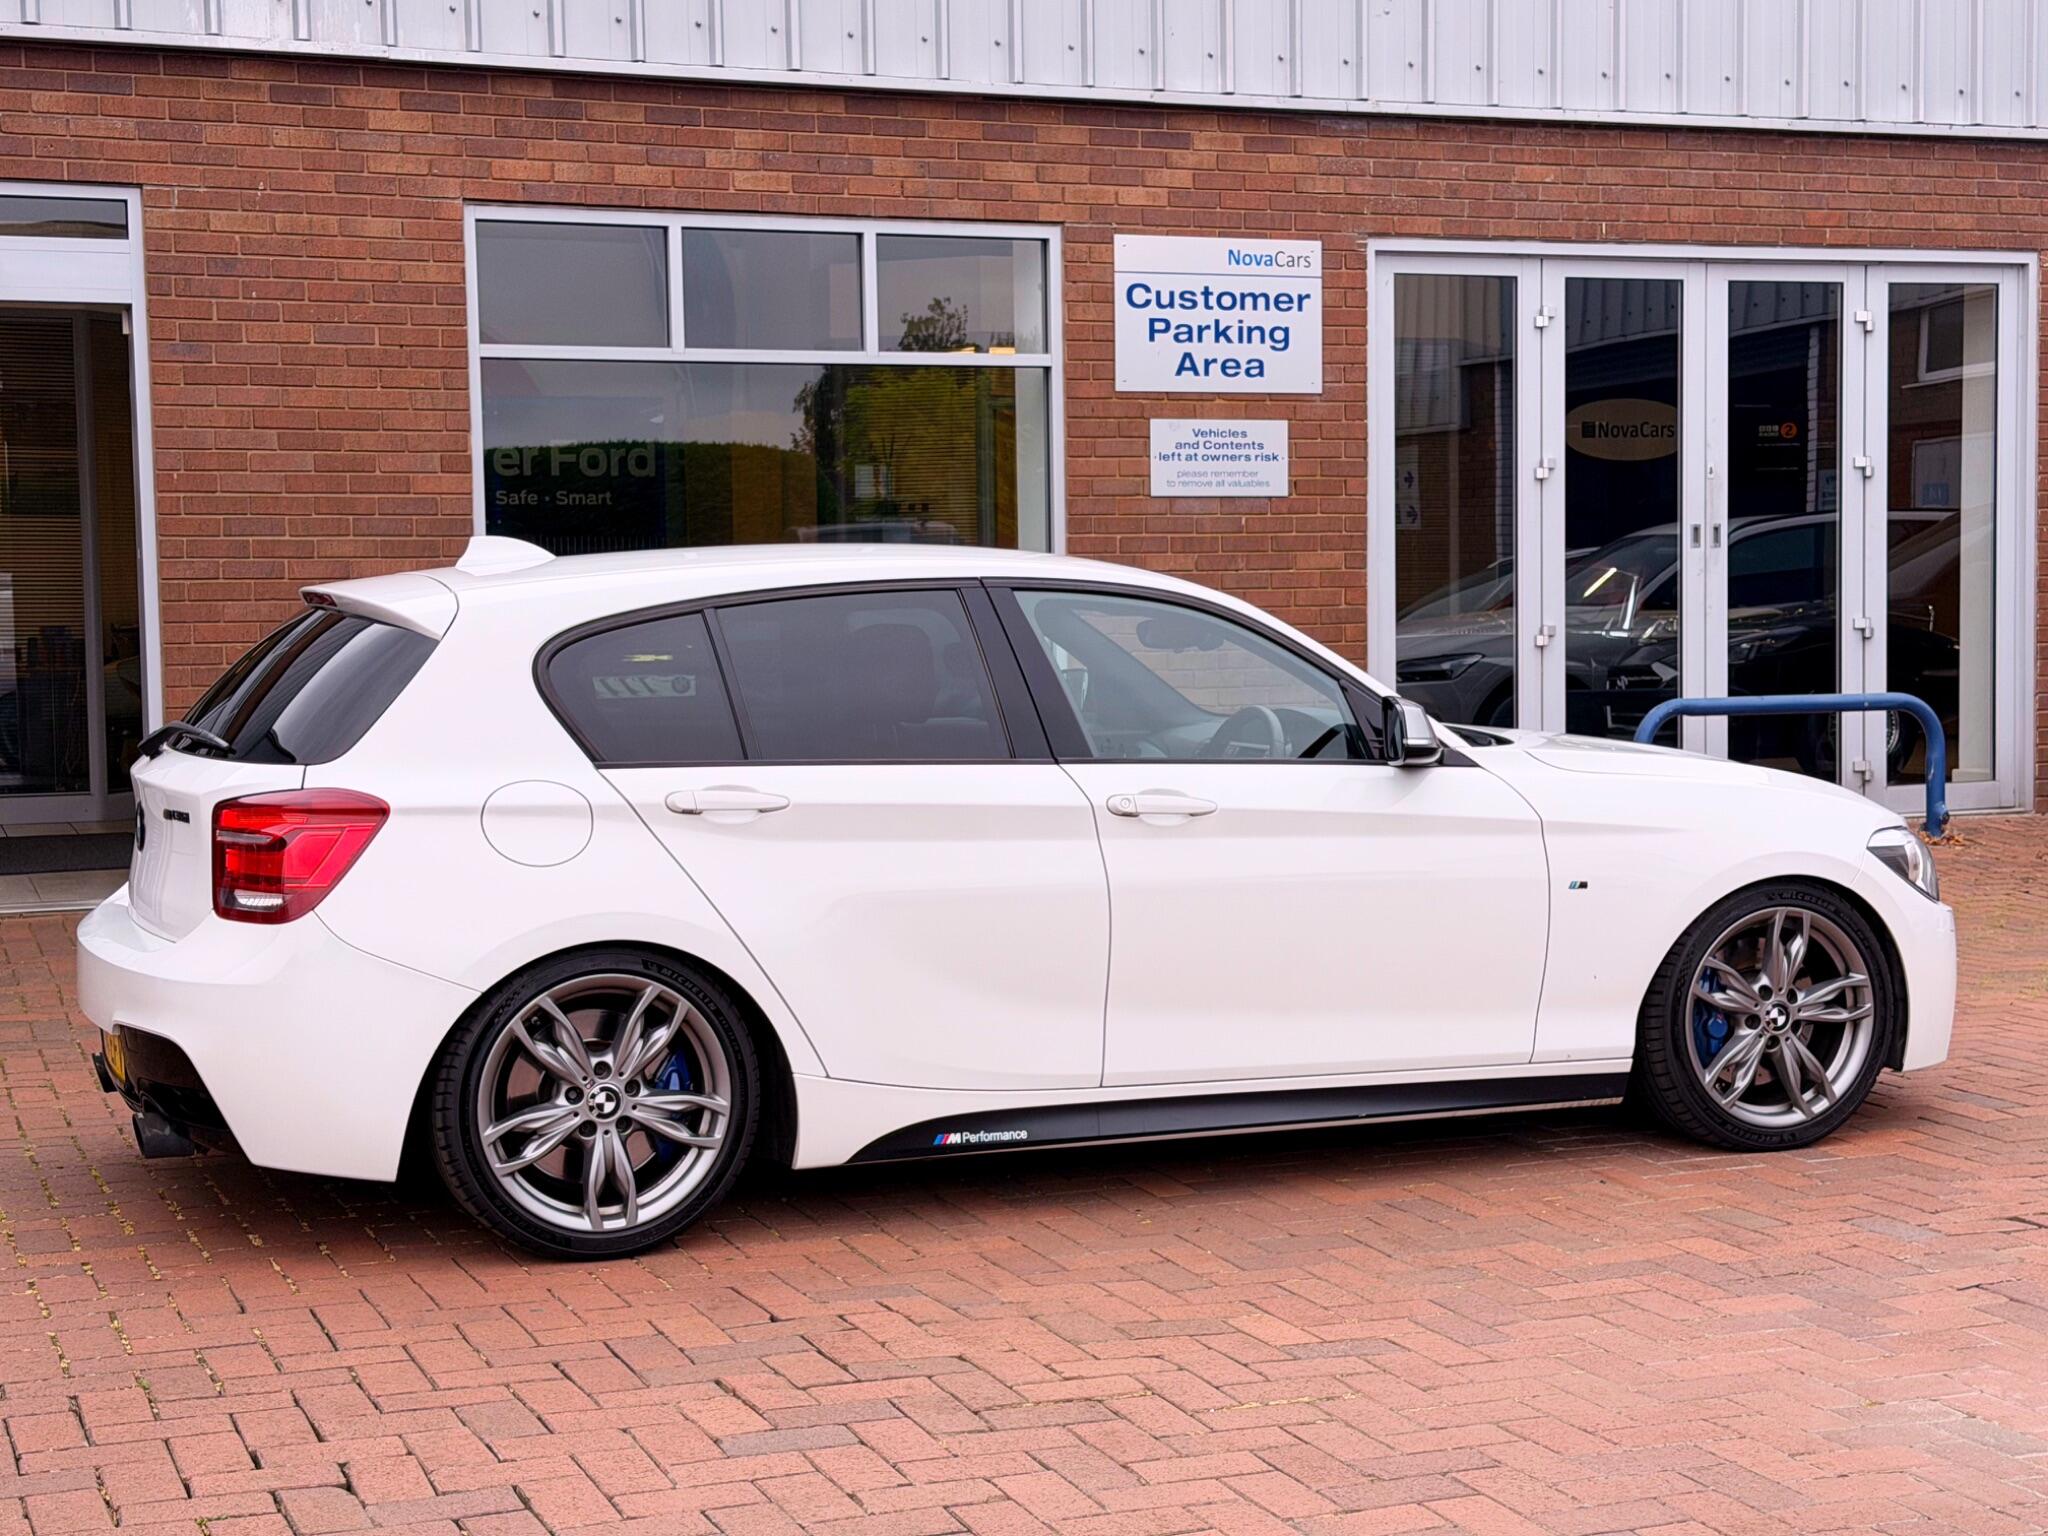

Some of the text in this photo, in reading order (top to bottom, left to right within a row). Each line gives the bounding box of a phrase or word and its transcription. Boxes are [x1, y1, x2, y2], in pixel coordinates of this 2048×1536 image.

[1228, 249, 1312, 268] NovaCars
[1126, 283, 1311, 312] Customer
[1148, 317, 1290, 351] Parking
[1174, 352, 1265, 378] Area
[1192, 428, 1248, 439] Vehicles
[1598, 421, 1675, 439] NovaCars
[1174, 440, 1265, 451] and Contents
[550, 441, 656, 478] Ford
[1158, 452, 1280, 462] left at owners risk
[1177, 469, 1259, 479] please remember
[1166, 479, 1270, 488] to remove all valuables
[495, 489, 613, 506] Safe Smart
[962, 1130, 1028, 1143] Performance
